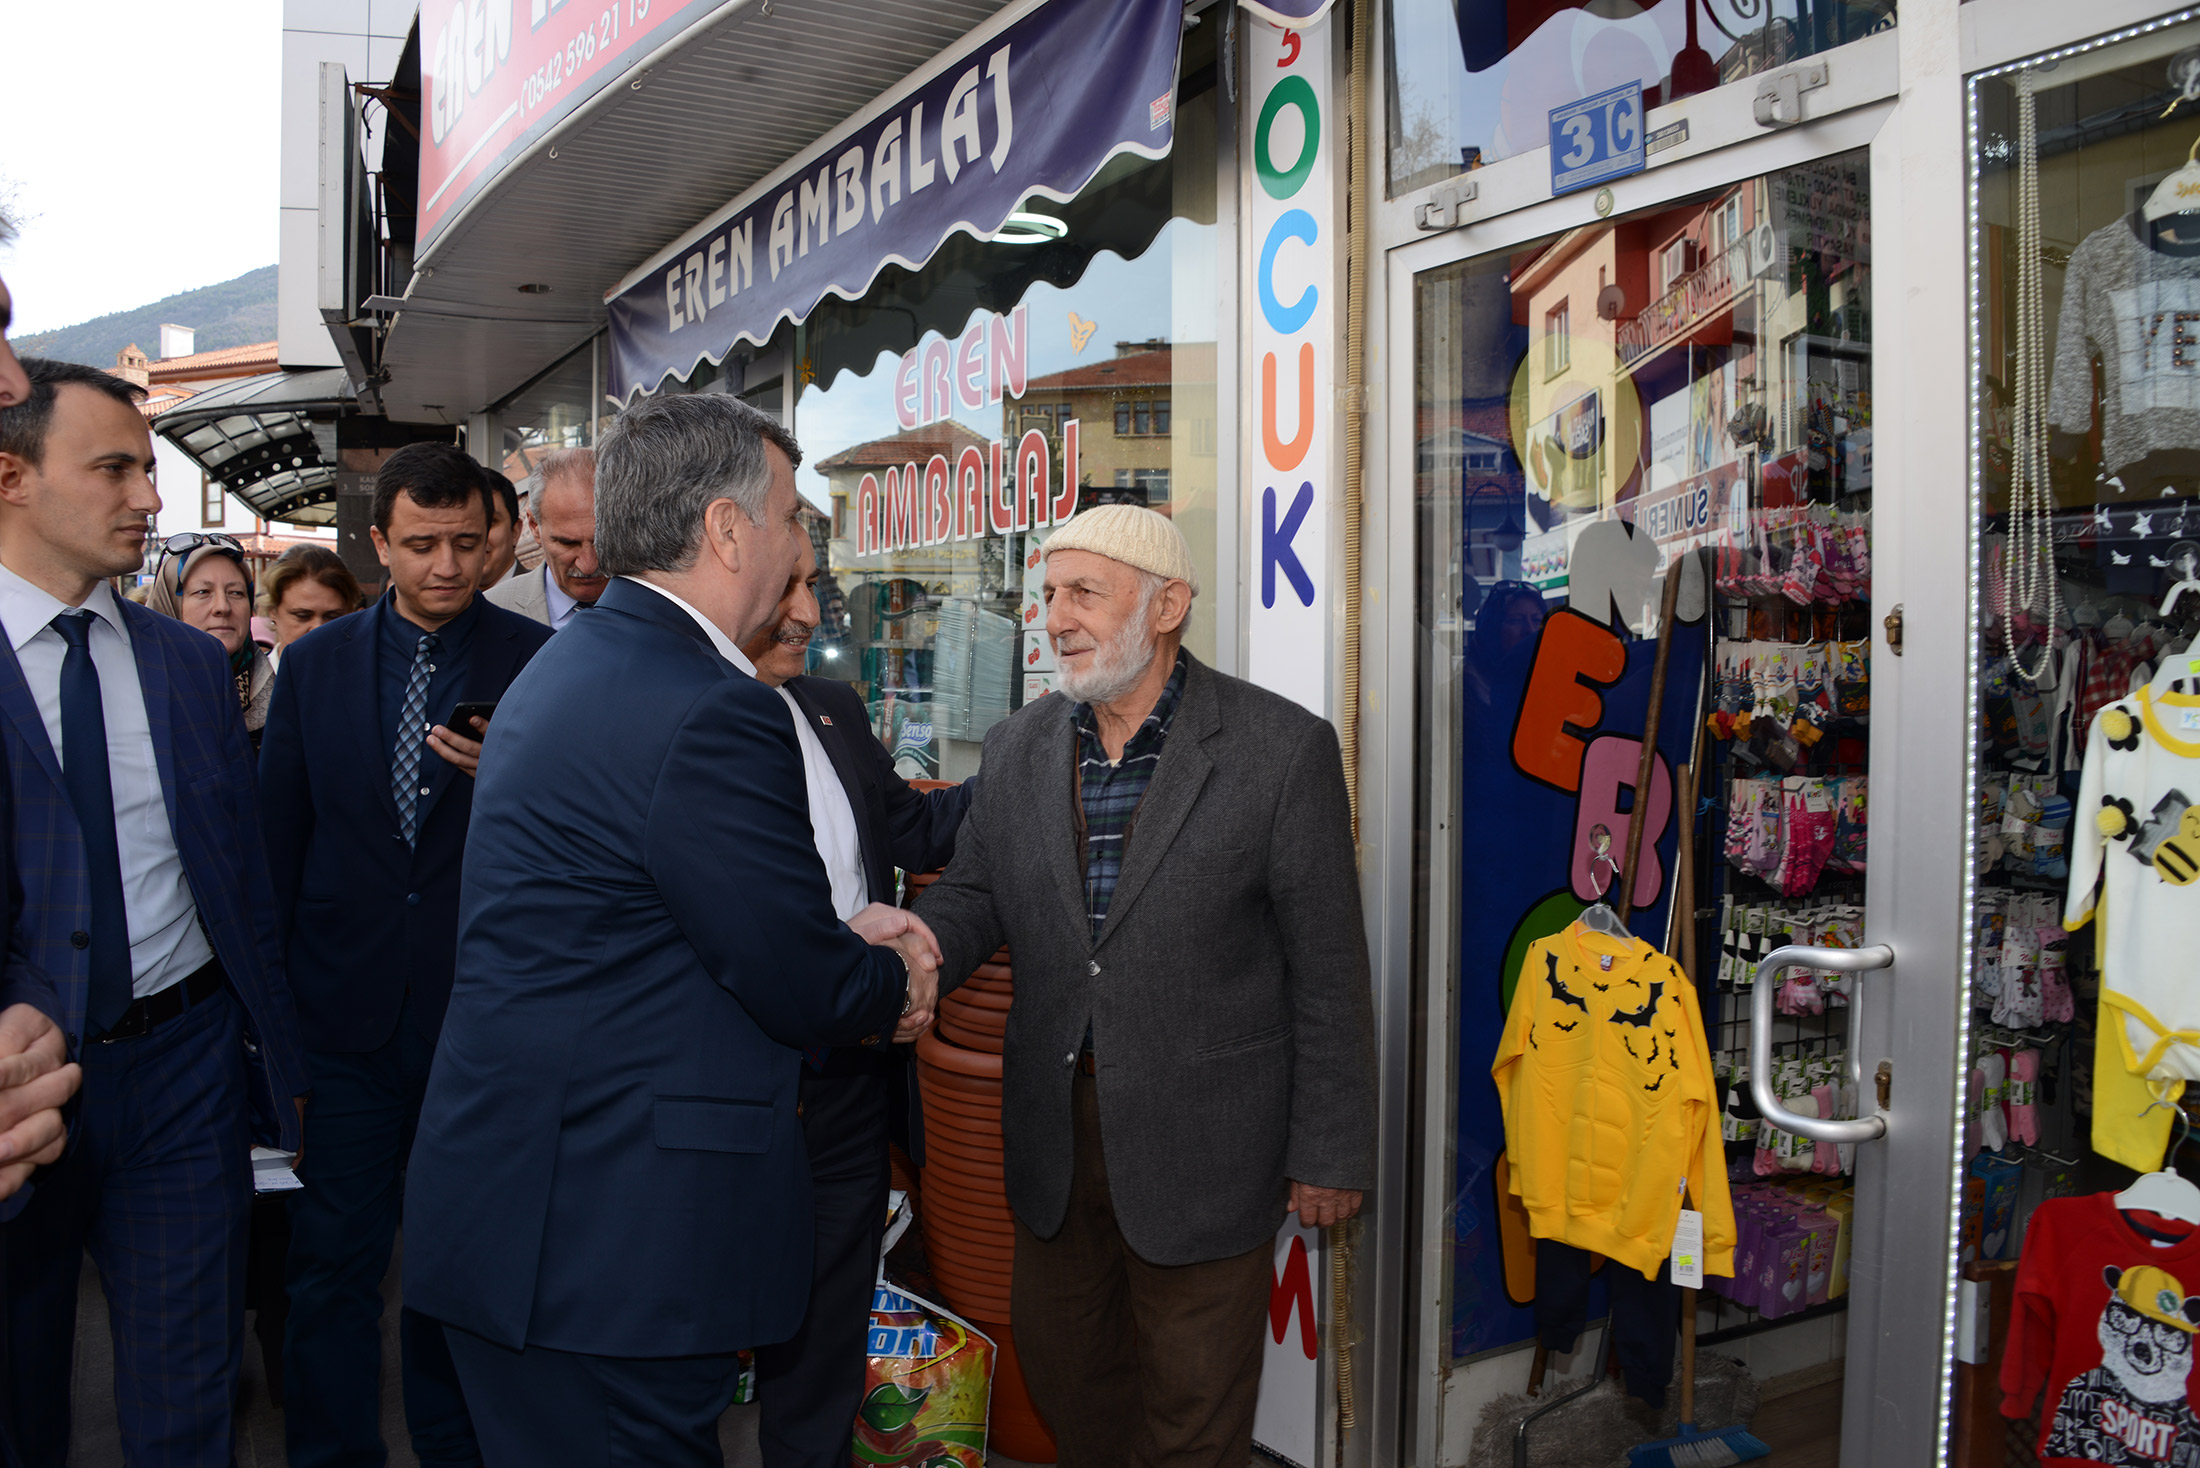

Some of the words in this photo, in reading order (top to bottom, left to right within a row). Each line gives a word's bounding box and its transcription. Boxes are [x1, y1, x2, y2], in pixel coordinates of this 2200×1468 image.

[527, 50, 564, 111] 0542
[565, 20, 597, 78] 596
[599, 2, 620, 52] 21
[665, 214, 754, 334] EREN
[767, 42, 1013, 283] AMBALAJ
[1560, 113, 1596, 169] 3
[1611, 99, 1635, 152] C
[894, 302, 1030, 432] EREN
[1253, 20, 1323, 608] OCUK
[856, 417, 1081, 559] AMBALAJ
[2101, 1399, 2175, 1458] SPORT
